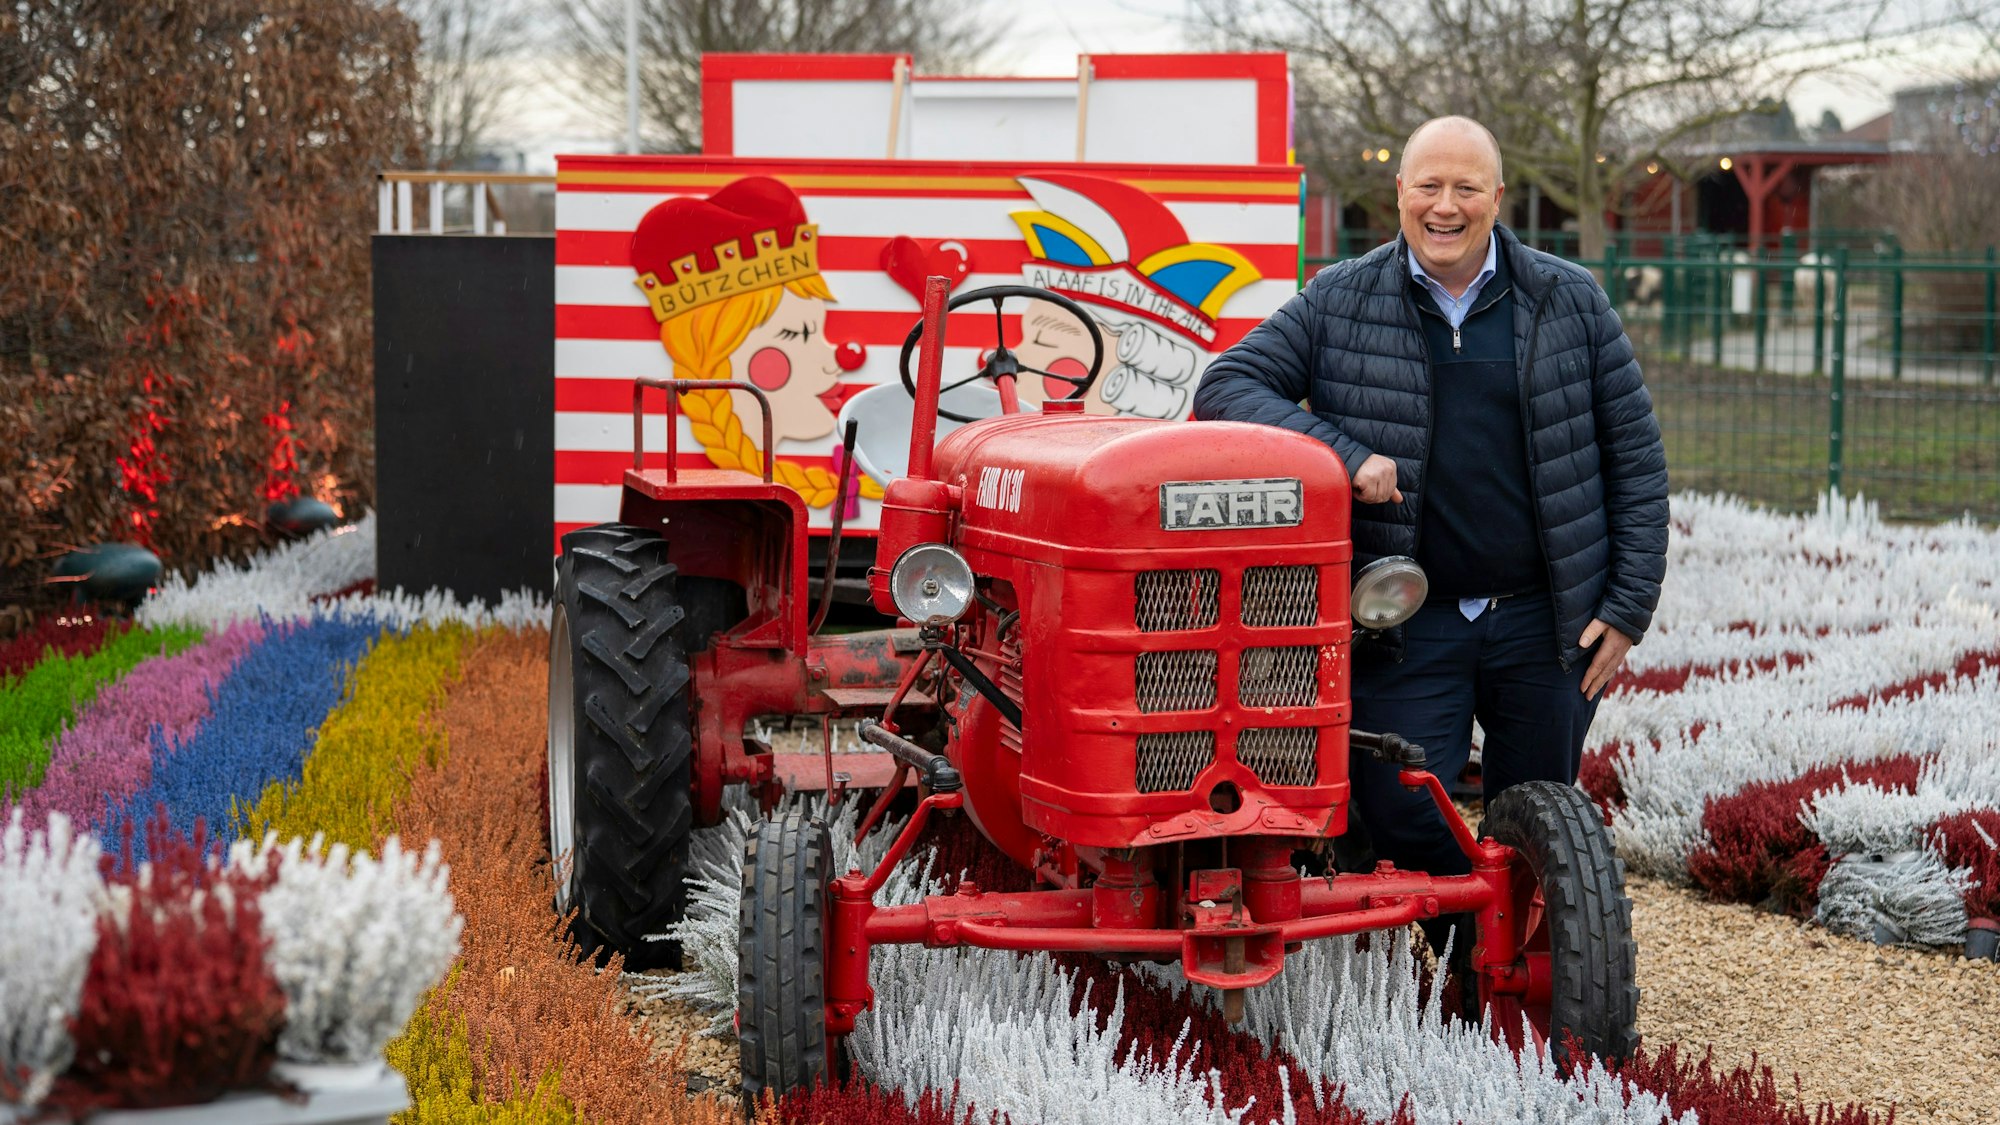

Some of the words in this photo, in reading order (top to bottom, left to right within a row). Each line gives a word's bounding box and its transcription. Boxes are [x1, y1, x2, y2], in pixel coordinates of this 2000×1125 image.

[659, 252, 809, 314] BÜTZCHEN
[1033, 269, 1094, 293] ALAAF
[1098, 276, 1119, 298] IS
[1124, 283, 1146, 305] IN
[1150, 292, 1177, 321] THE
[1177, 311, 1209, 337] AIR
[976, 466, 1001, 510] FAHR
[998, 468, 1025, 513] D130
[1166, 482, 1298, 525] FAHR
